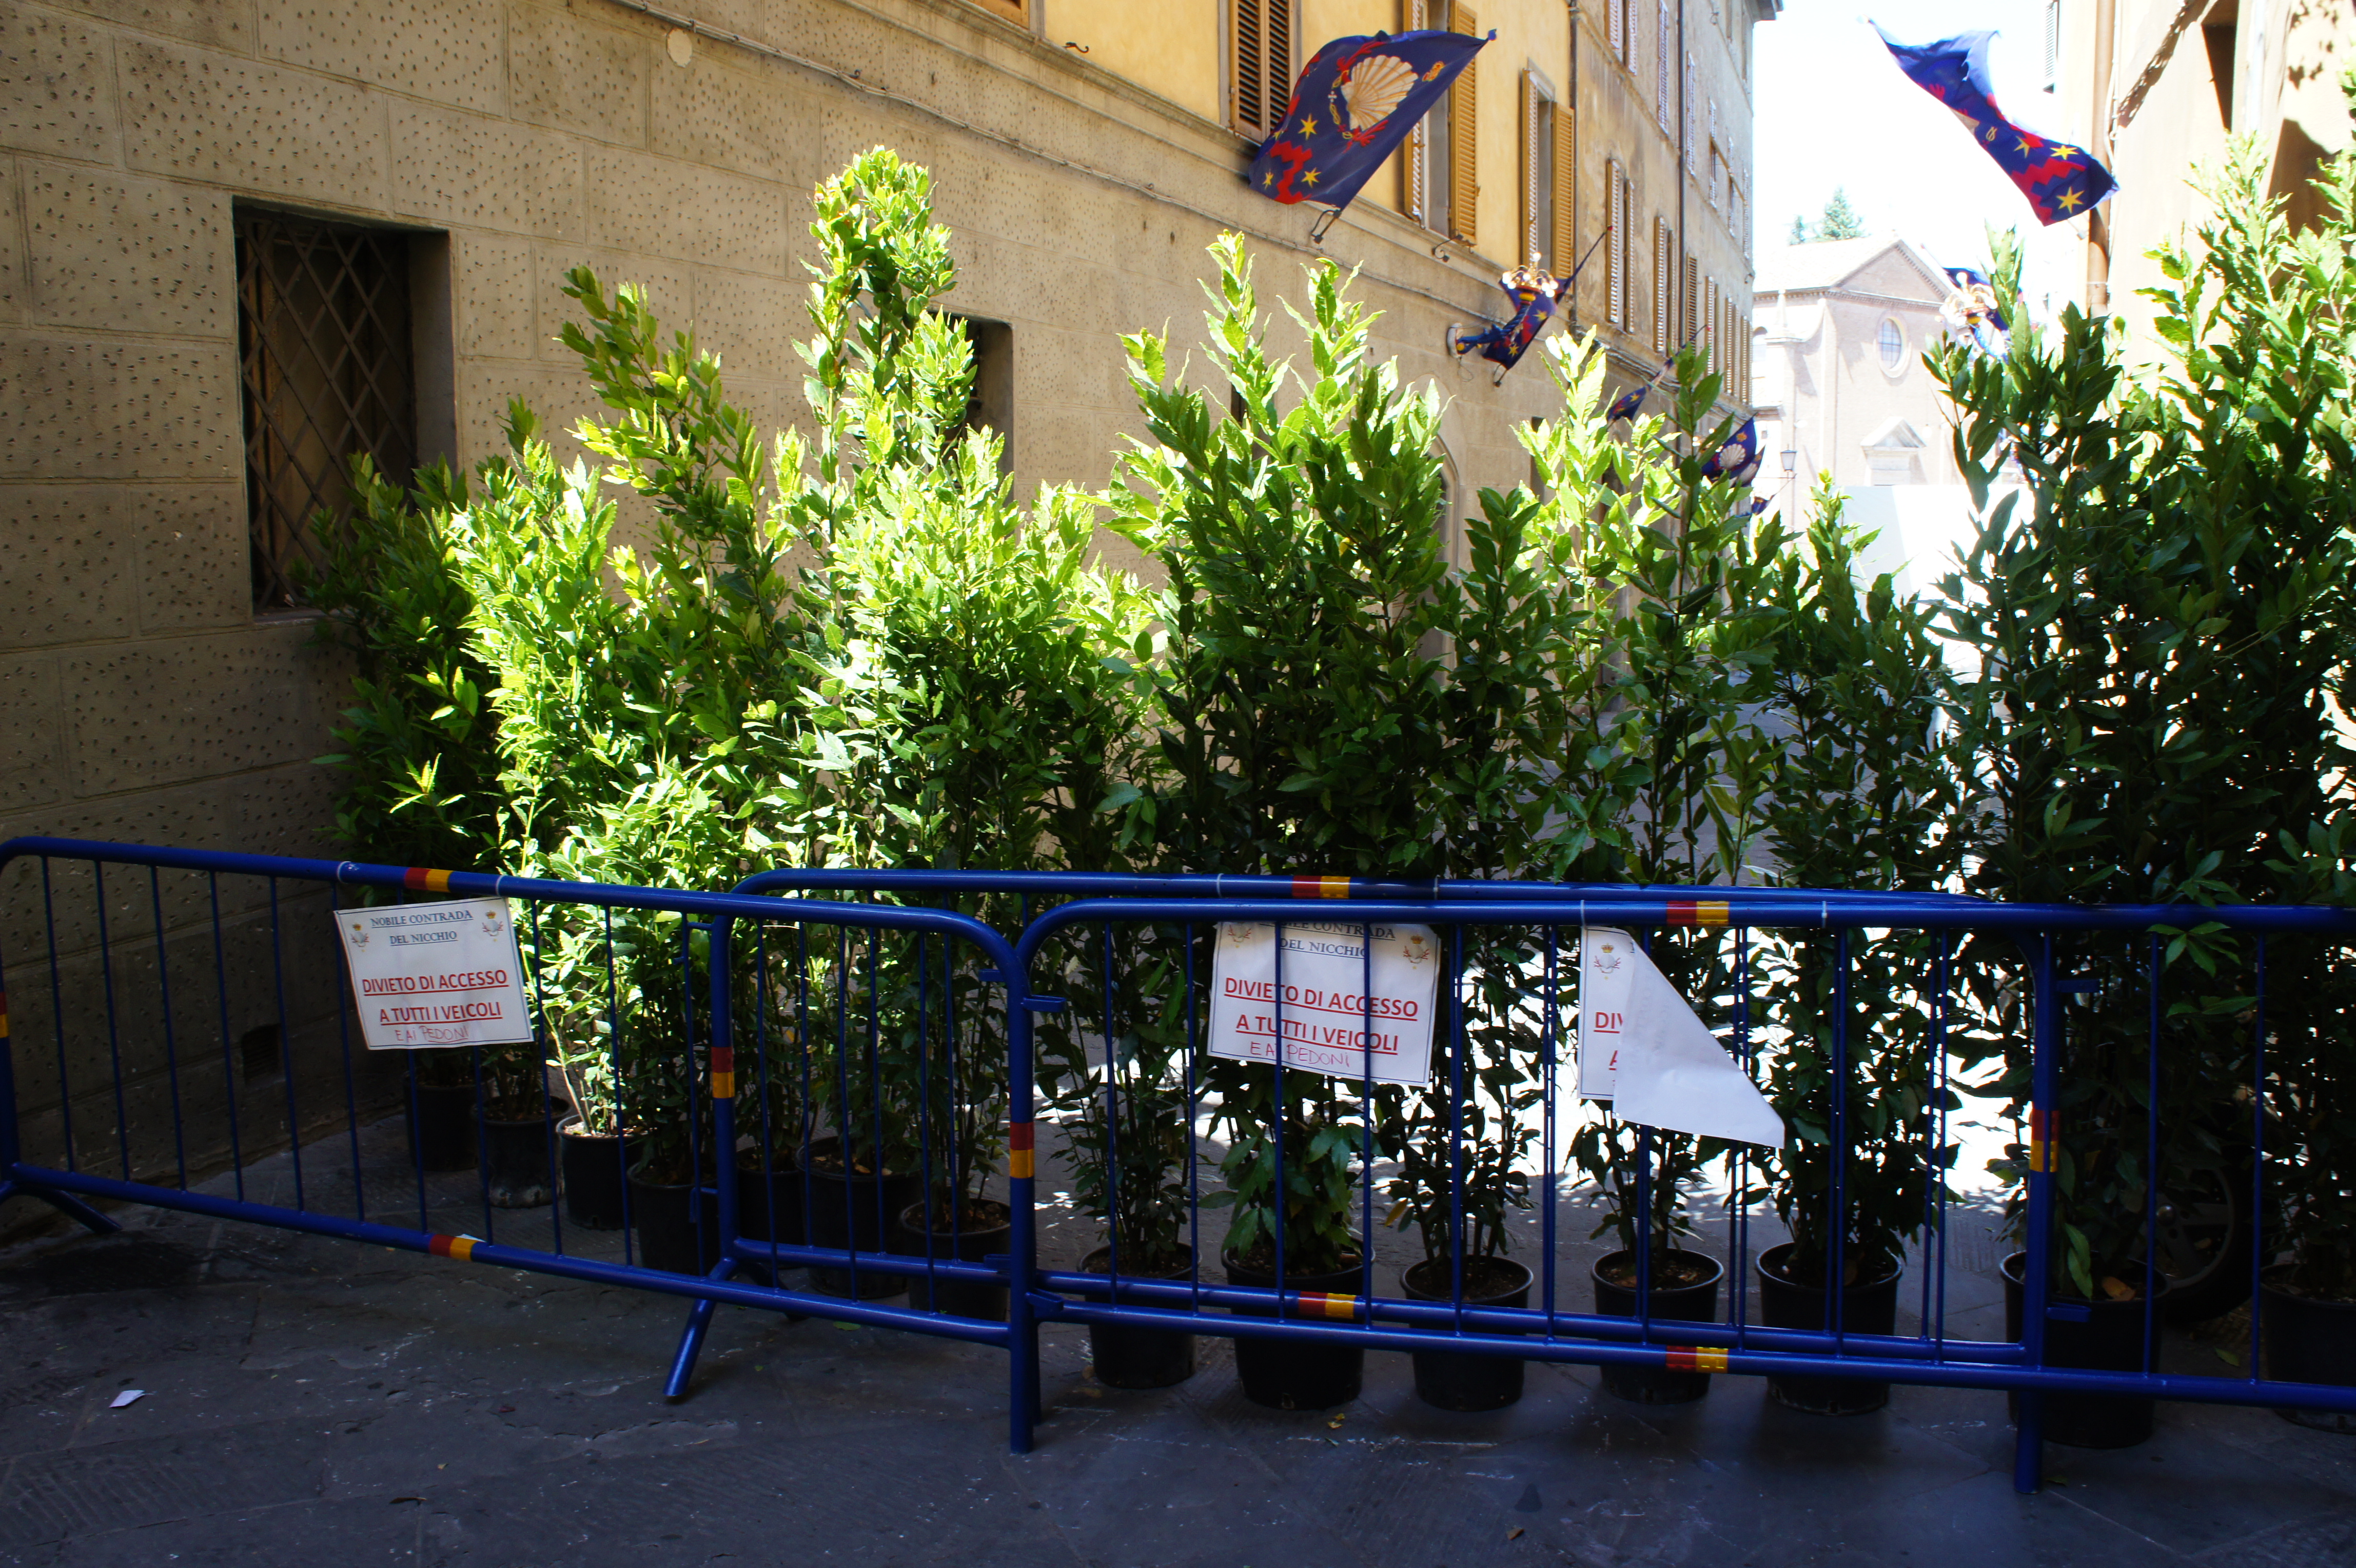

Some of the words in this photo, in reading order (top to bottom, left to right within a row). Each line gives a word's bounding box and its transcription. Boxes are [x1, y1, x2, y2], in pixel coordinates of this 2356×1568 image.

[370, 916, 406, 927] NOBILE
[409, 910, 473, 924] CONTRADA
[390, 934, 408, 945] DEL
[411, 931, 457, 943] NICCHIO
[1281, 938, 1304, 950] DEL
[362, 977, 416, 992] DIVIETO
[419, 975, 435, 990] DI
[439, 969, 507, 989] ACCESSO
[1304, 989, 1322, 1006] DI
[1329, 993, 1418, 1017] ACCESSO
[380, 1009, 390, 1023] A
[391, 1007, 430, 1022] TUTTI
[435, 1006, 438, 1020] I
[441, 1002, 501, 1020] VEICOLI
[395, 1030, 404, 1041] E
[1236, 1014, 1249, 1030] A
[1255, 1016, 1306, 1038] TUTTI
[1313, 1025, 1317, 1041] I
[1323, 1027, 1399, 1051] VEICOLI
[1250, 1042, 1261, 1055] E
